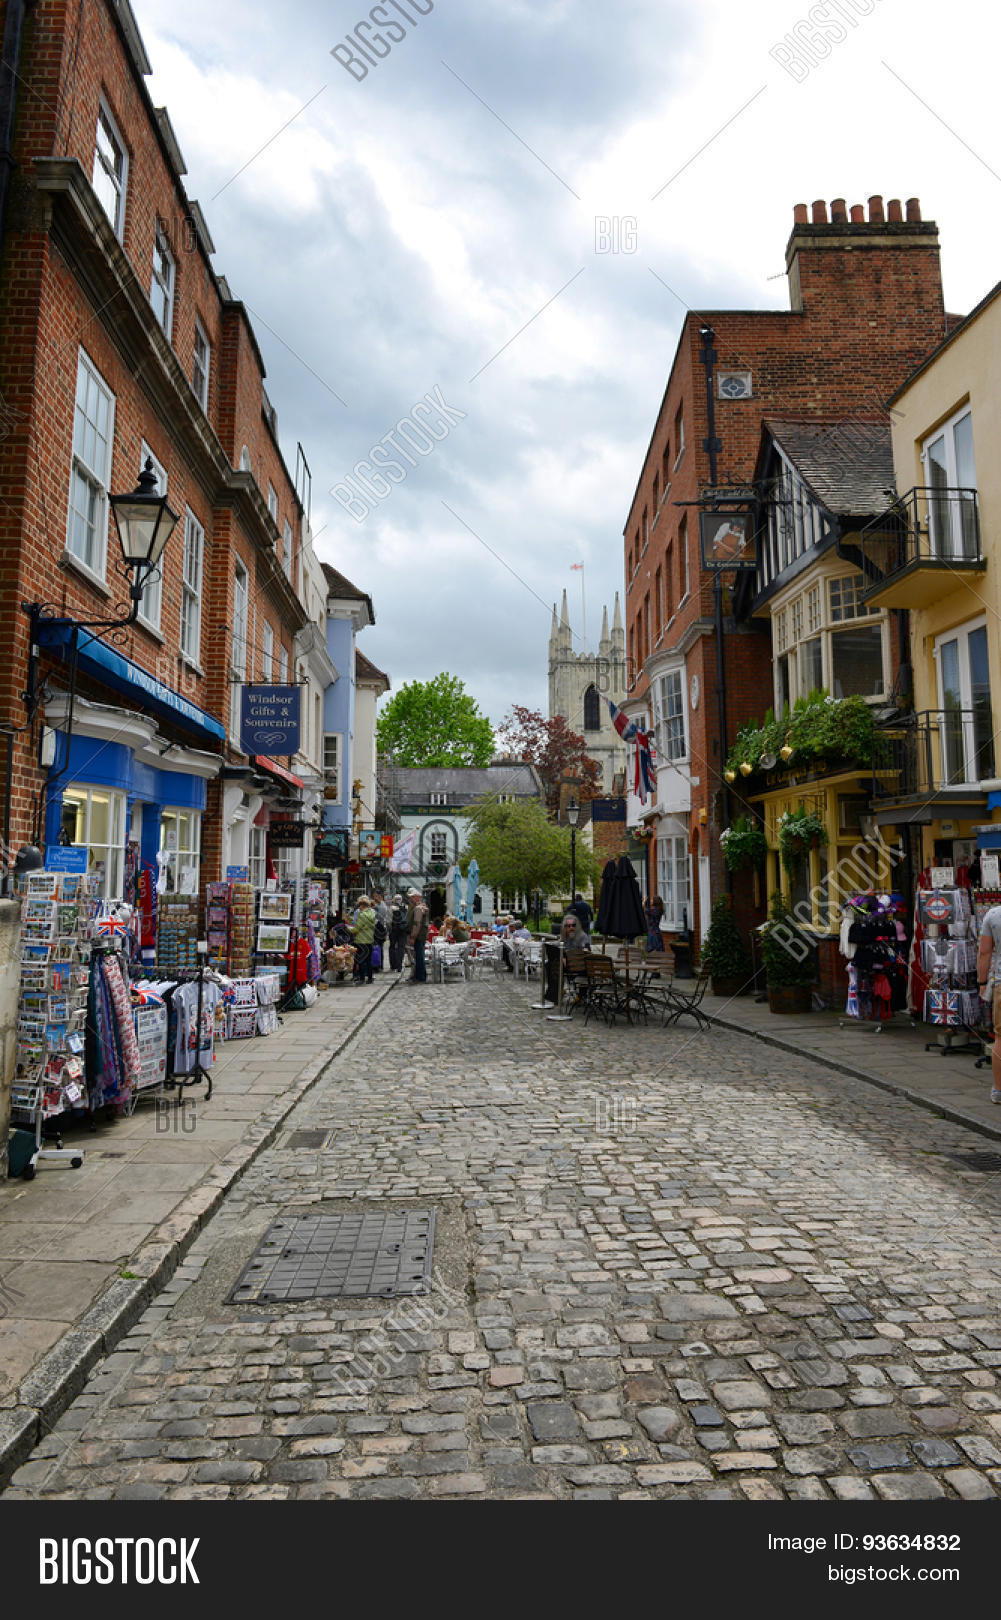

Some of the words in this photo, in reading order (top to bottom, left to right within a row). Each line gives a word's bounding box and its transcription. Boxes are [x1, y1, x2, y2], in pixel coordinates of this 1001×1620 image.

[248, 694, 293, 704] Windsor
[250, 705, 275, 716] Gifts
[281, 706, 289, 716] &
[244, 717, 297, 728] Souvenirs
